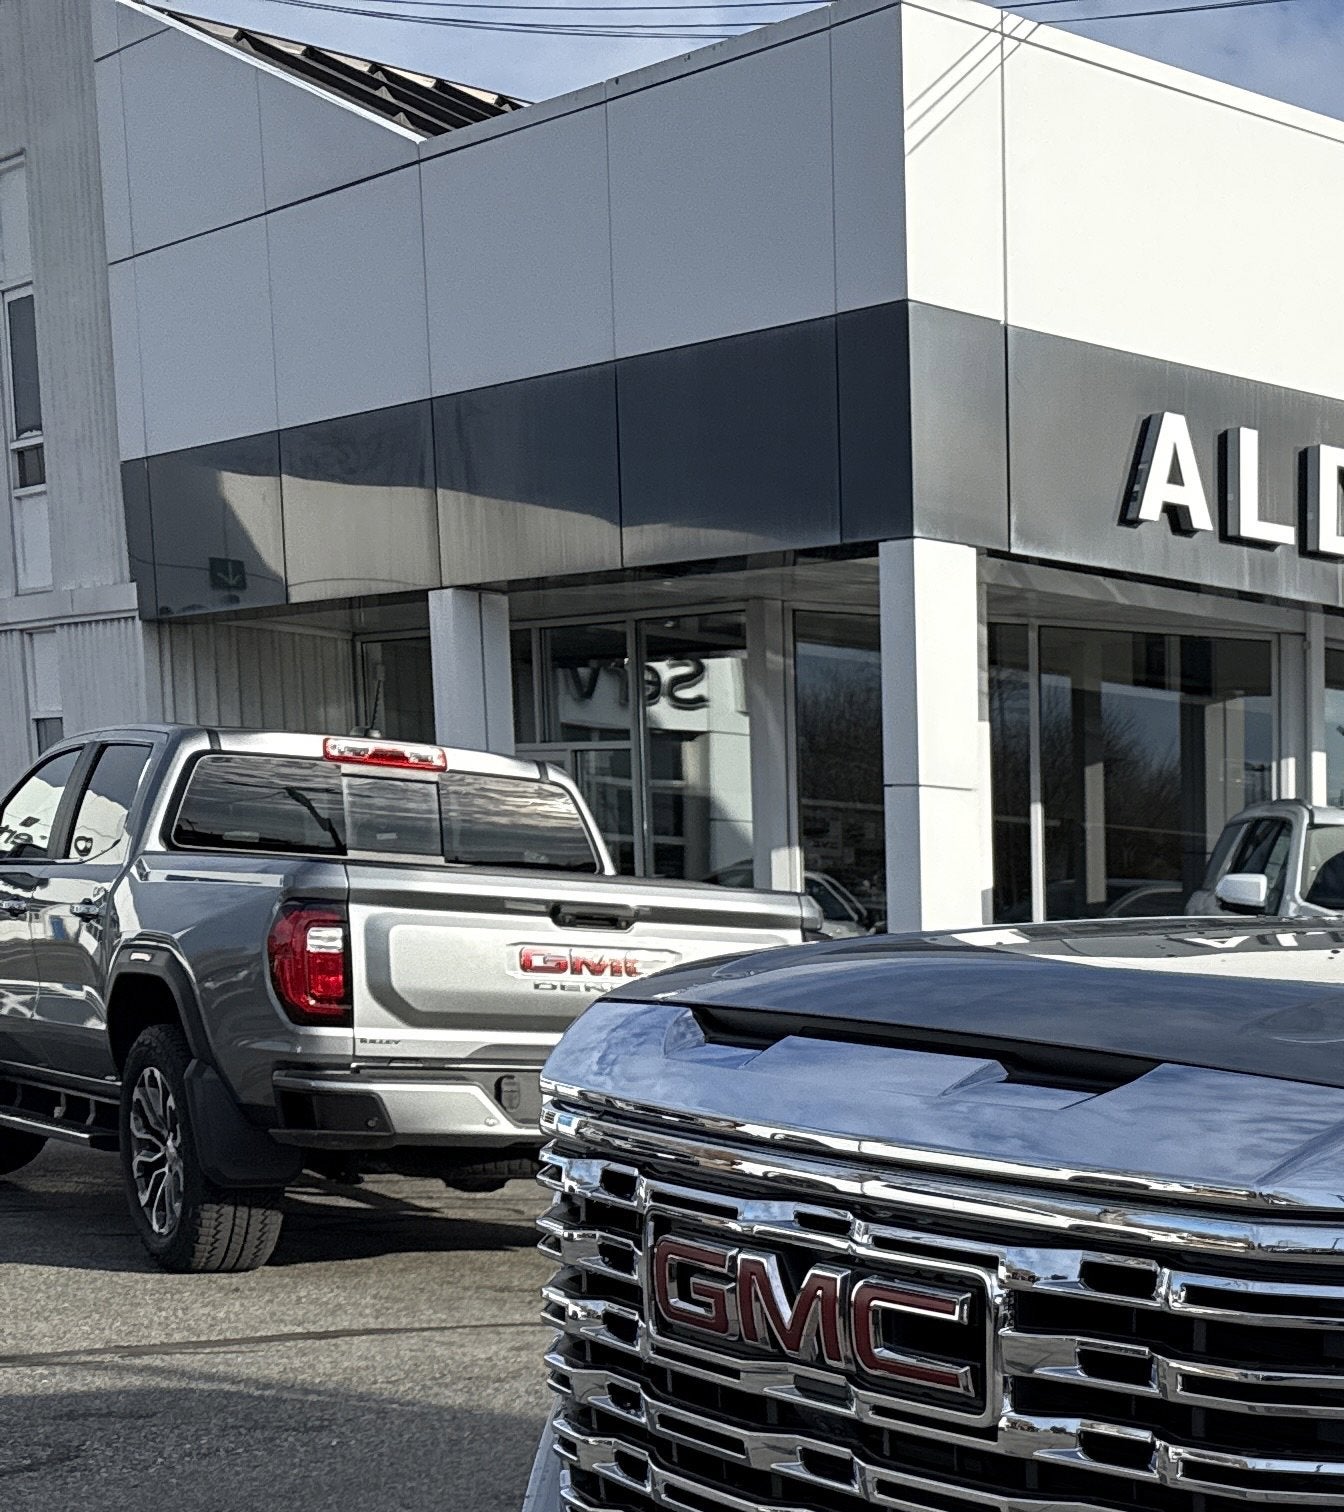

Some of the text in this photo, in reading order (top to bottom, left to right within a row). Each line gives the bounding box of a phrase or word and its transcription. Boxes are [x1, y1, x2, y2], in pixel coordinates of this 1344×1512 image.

[519, 946, 670, 978] GMC
[534, 982, 612, 992] DEN
[654, 1234, 974, 1398] GMC
